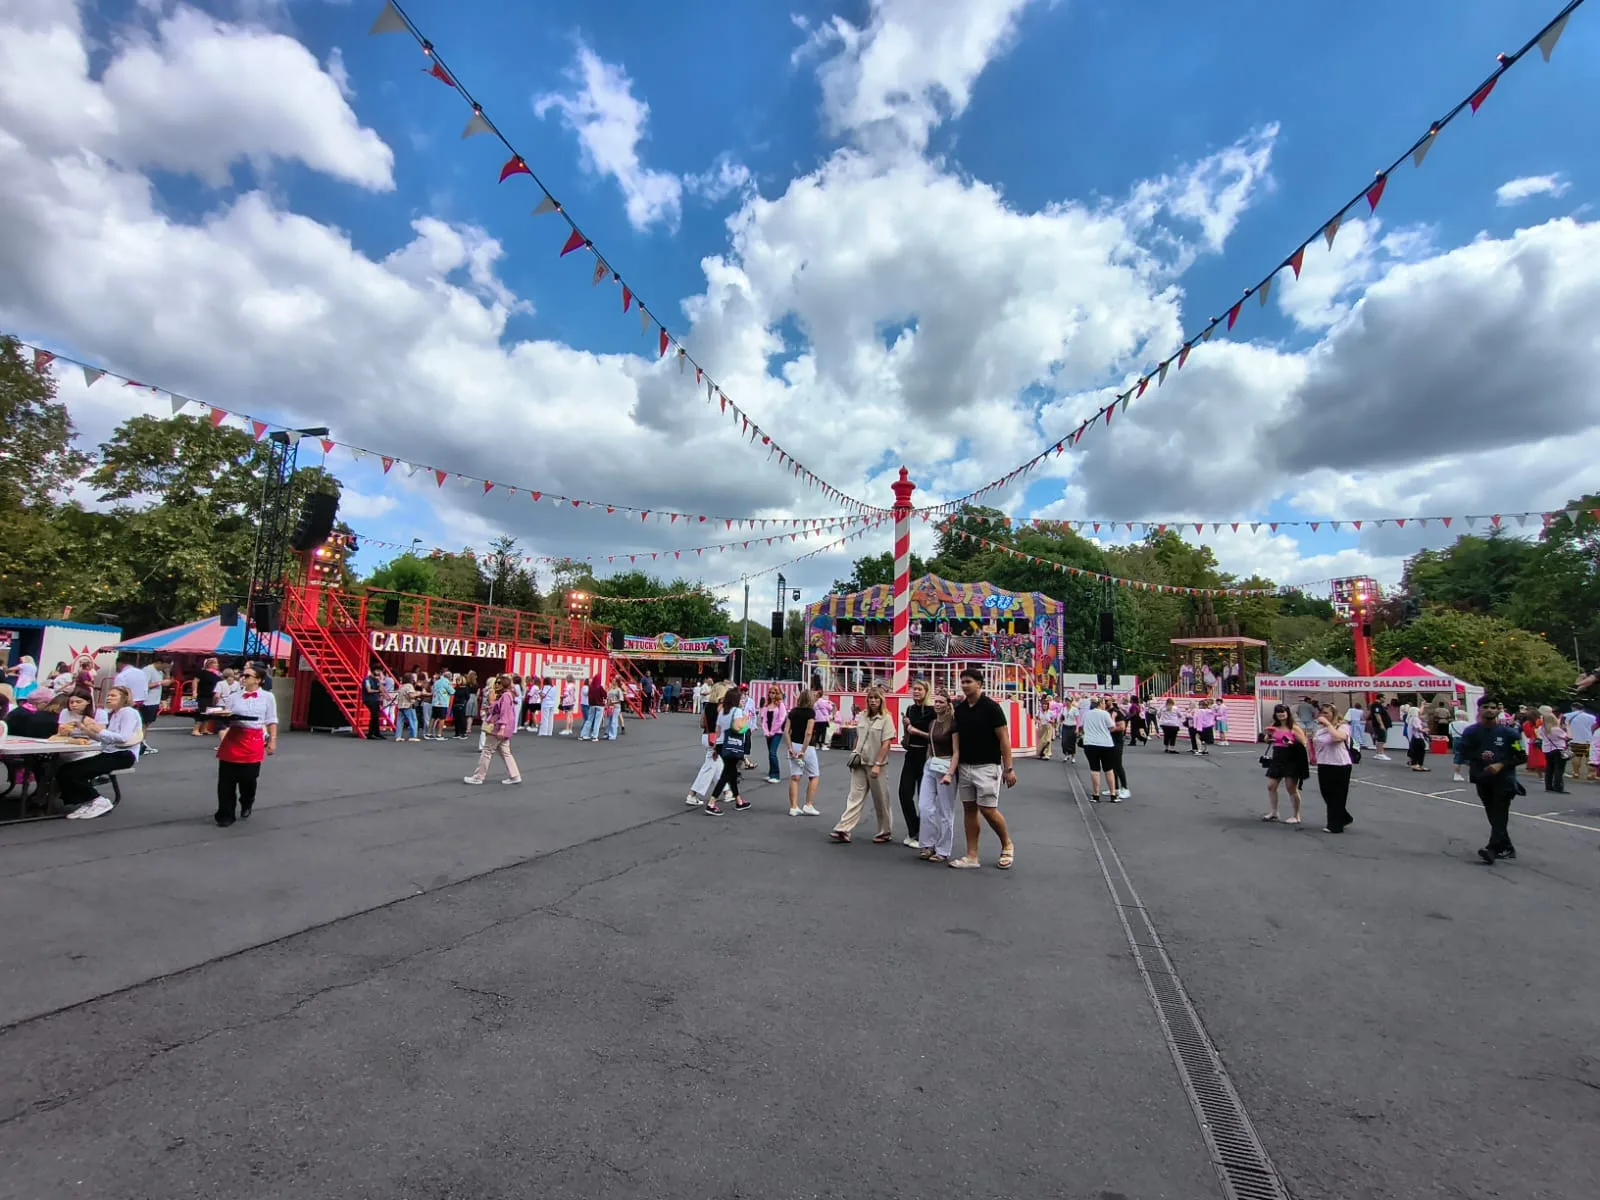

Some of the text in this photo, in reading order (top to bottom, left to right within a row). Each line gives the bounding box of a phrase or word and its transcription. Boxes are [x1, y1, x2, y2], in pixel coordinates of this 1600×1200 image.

[953, 592, 1023, 610] CIRCUS
[371, 631, 508, 659] CARNIVAL BAR
[623, 639, 709, 651] ENTUCKY DERBY
[1259, 679, 1279, 687] MAC
[1288, 679, 1321, 687] CHEESE
[1373, 680, 1413, 688] SALADS
[1418, 679, 1452, 687] CHILLI
